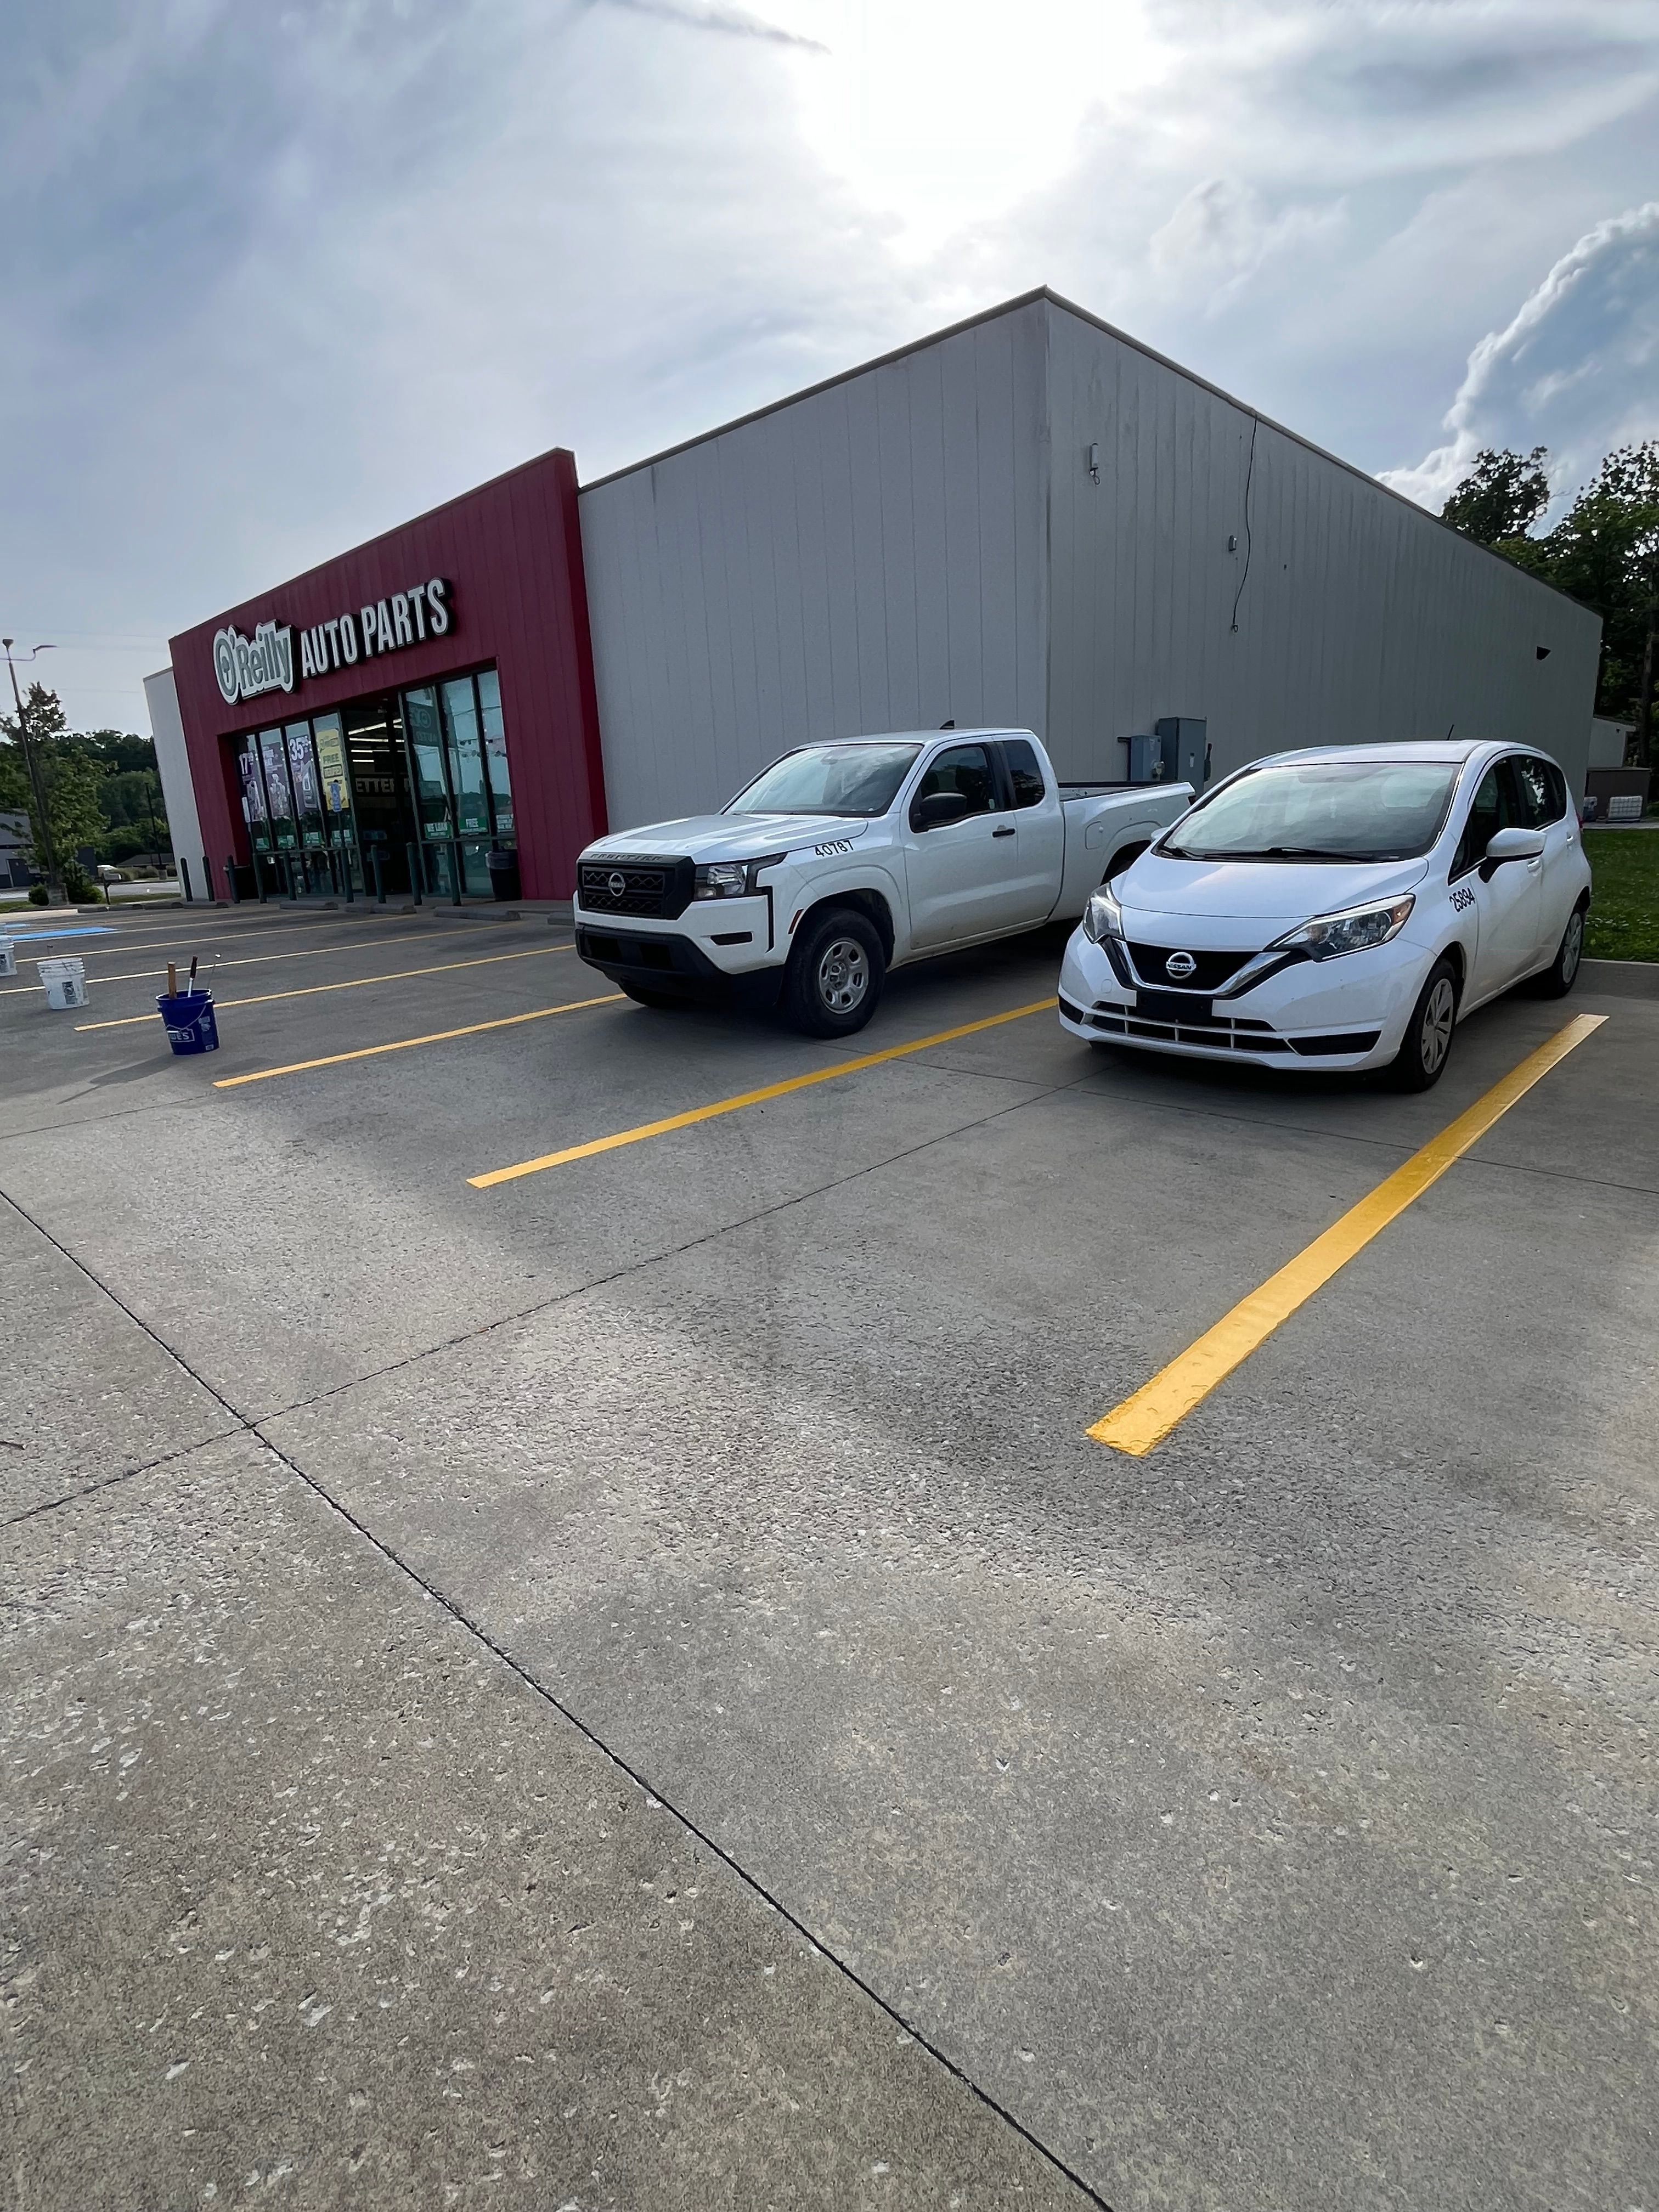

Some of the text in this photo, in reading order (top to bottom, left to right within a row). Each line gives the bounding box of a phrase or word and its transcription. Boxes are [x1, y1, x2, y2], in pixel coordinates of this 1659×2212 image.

[213, 577, 449, 699] O'Reilly AUTO PARTS
[323, 753, 340, 764] FREE
[815, 839, 854, 856] 40787
[1449, 888, 1476, 912] 25894
